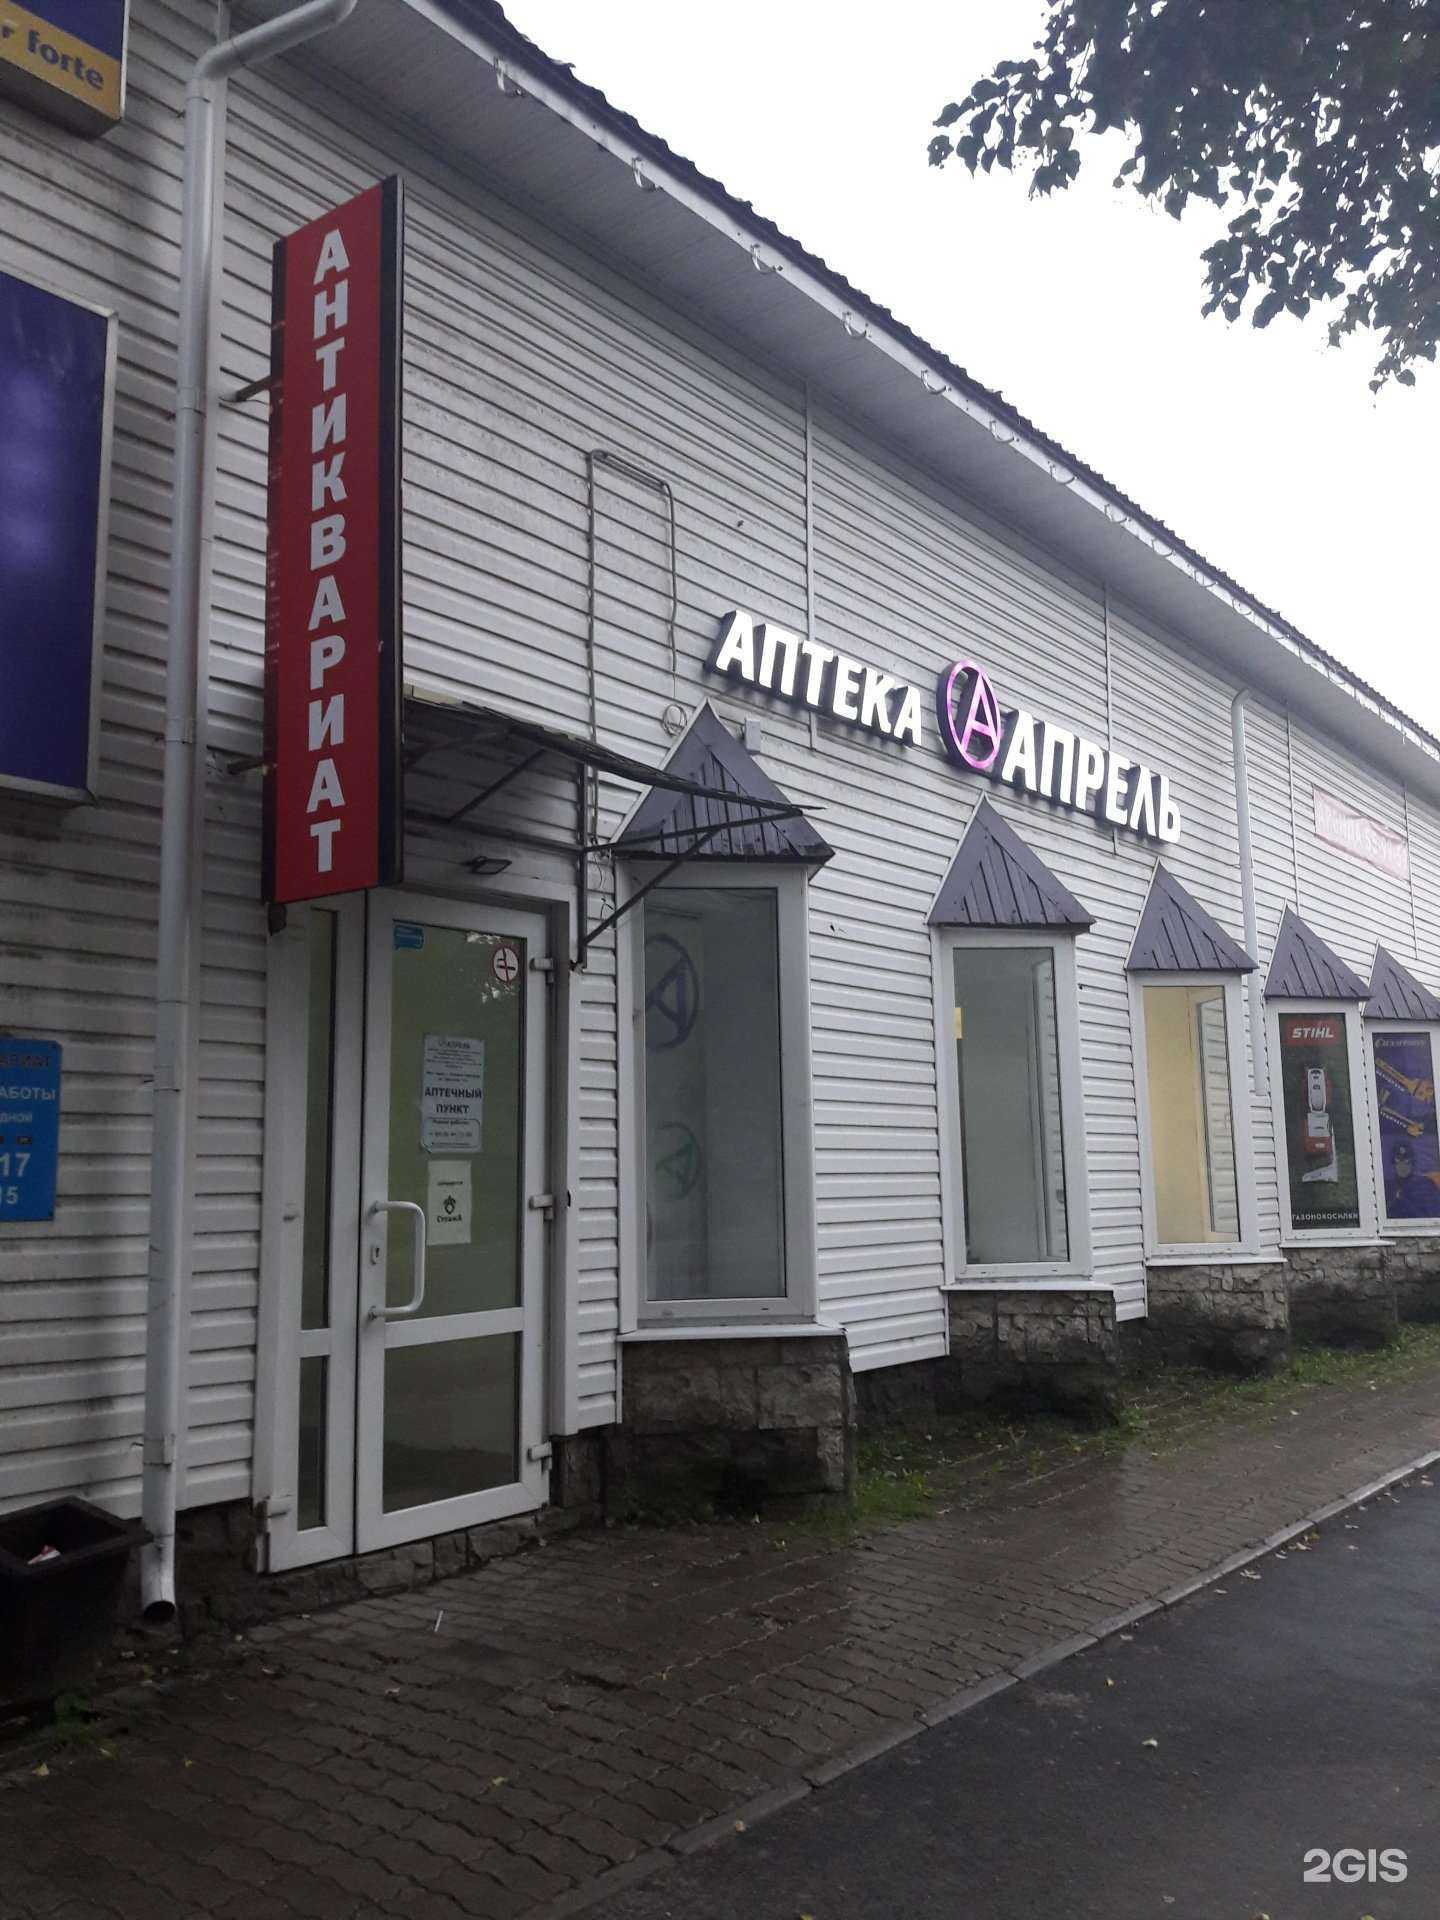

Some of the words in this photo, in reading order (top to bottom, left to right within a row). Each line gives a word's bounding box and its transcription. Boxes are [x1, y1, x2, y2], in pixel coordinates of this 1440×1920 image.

[28, 29, 104, 91] forte
[306, 229, 350, 874] АНТИКВАРИАТ
[713, 609, 923, 746] АПТЕКА
[1001, 708, 1182, 844] АПРЕЛЬ
[1291, 1026, 1335, 1039] STIHL
[424, 1086, 482, 1099] АПТЕЧНЫЙ
[436, 1103, 470, 1114] ПУНКТ
